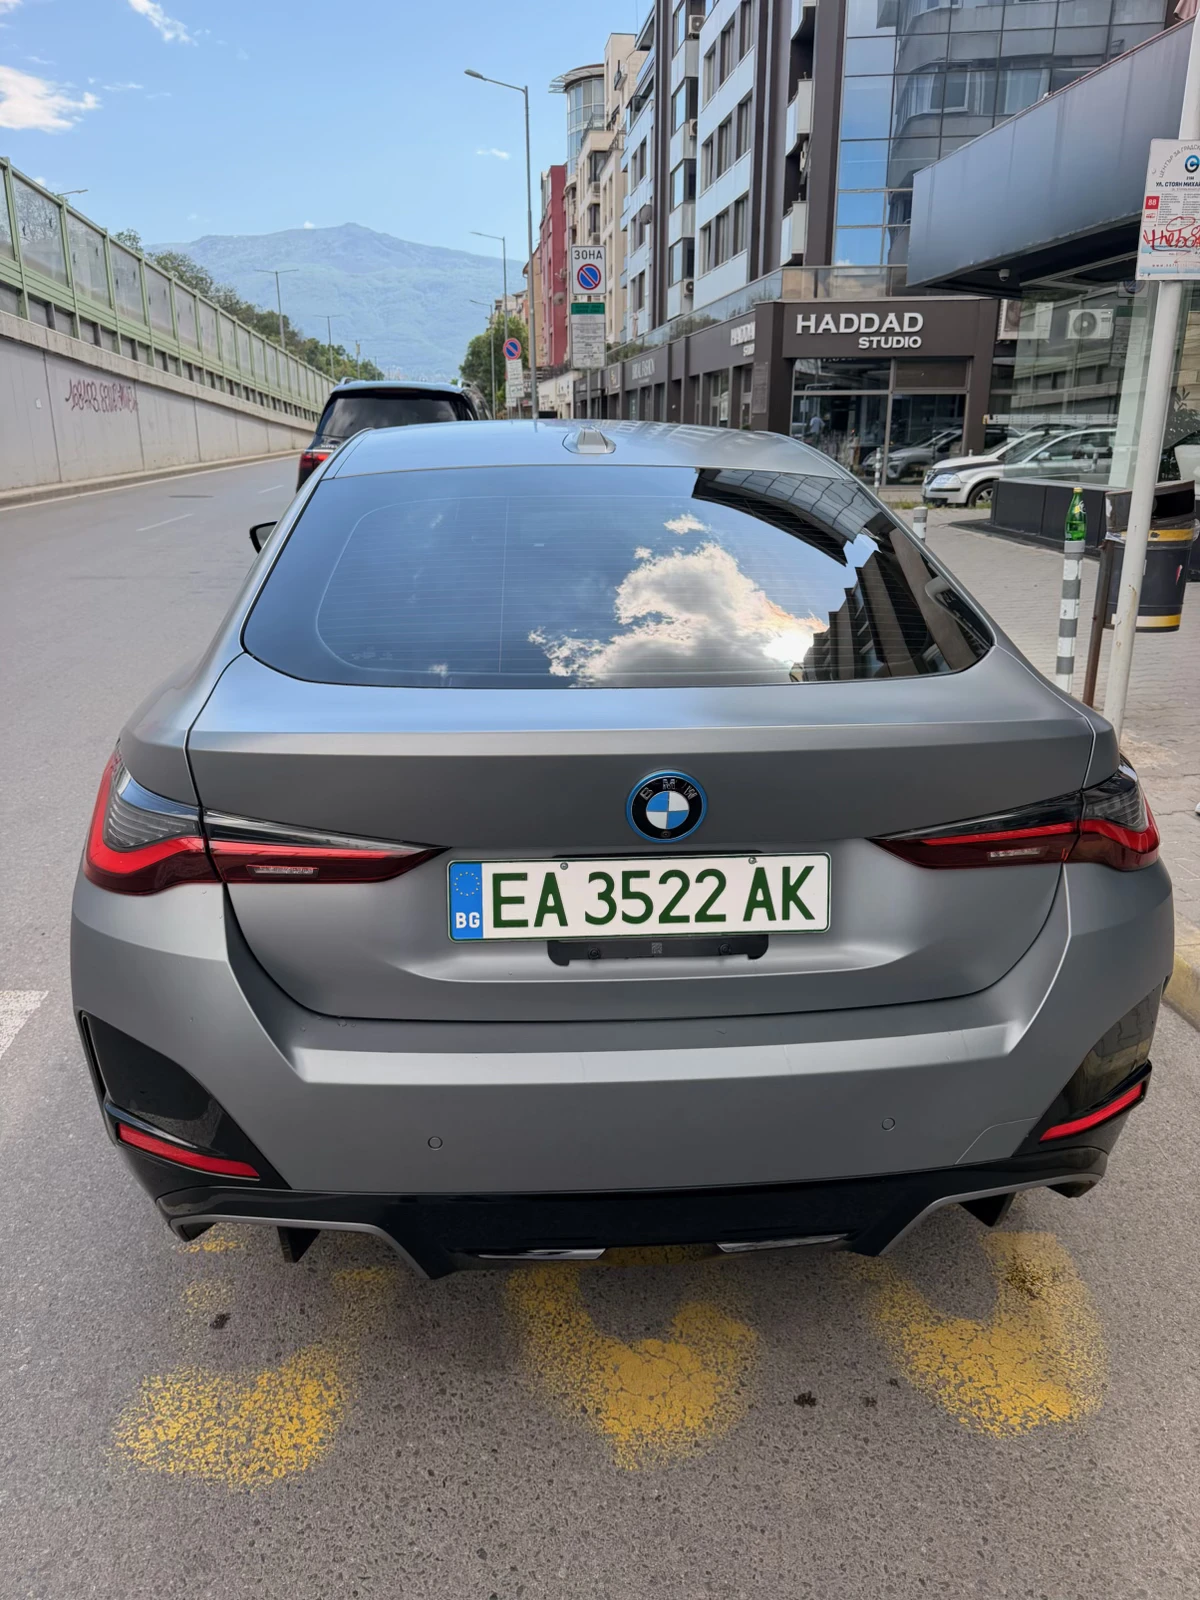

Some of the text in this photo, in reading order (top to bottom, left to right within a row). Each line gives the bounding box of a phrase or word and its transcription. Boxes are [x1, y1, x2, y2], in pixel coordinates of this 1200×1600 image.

[1148, 198, 1157, 206] 88
[574, 250, 603, 260] ЗОНА
[796, 312, 924, 334] HADDAD
[858, 336, 922, 349] STUDIO
[640, 778, 698, 801] BMW
[492, 866, 815, 928] EA 3522 AK
[455, 912, 480, 928] BG
